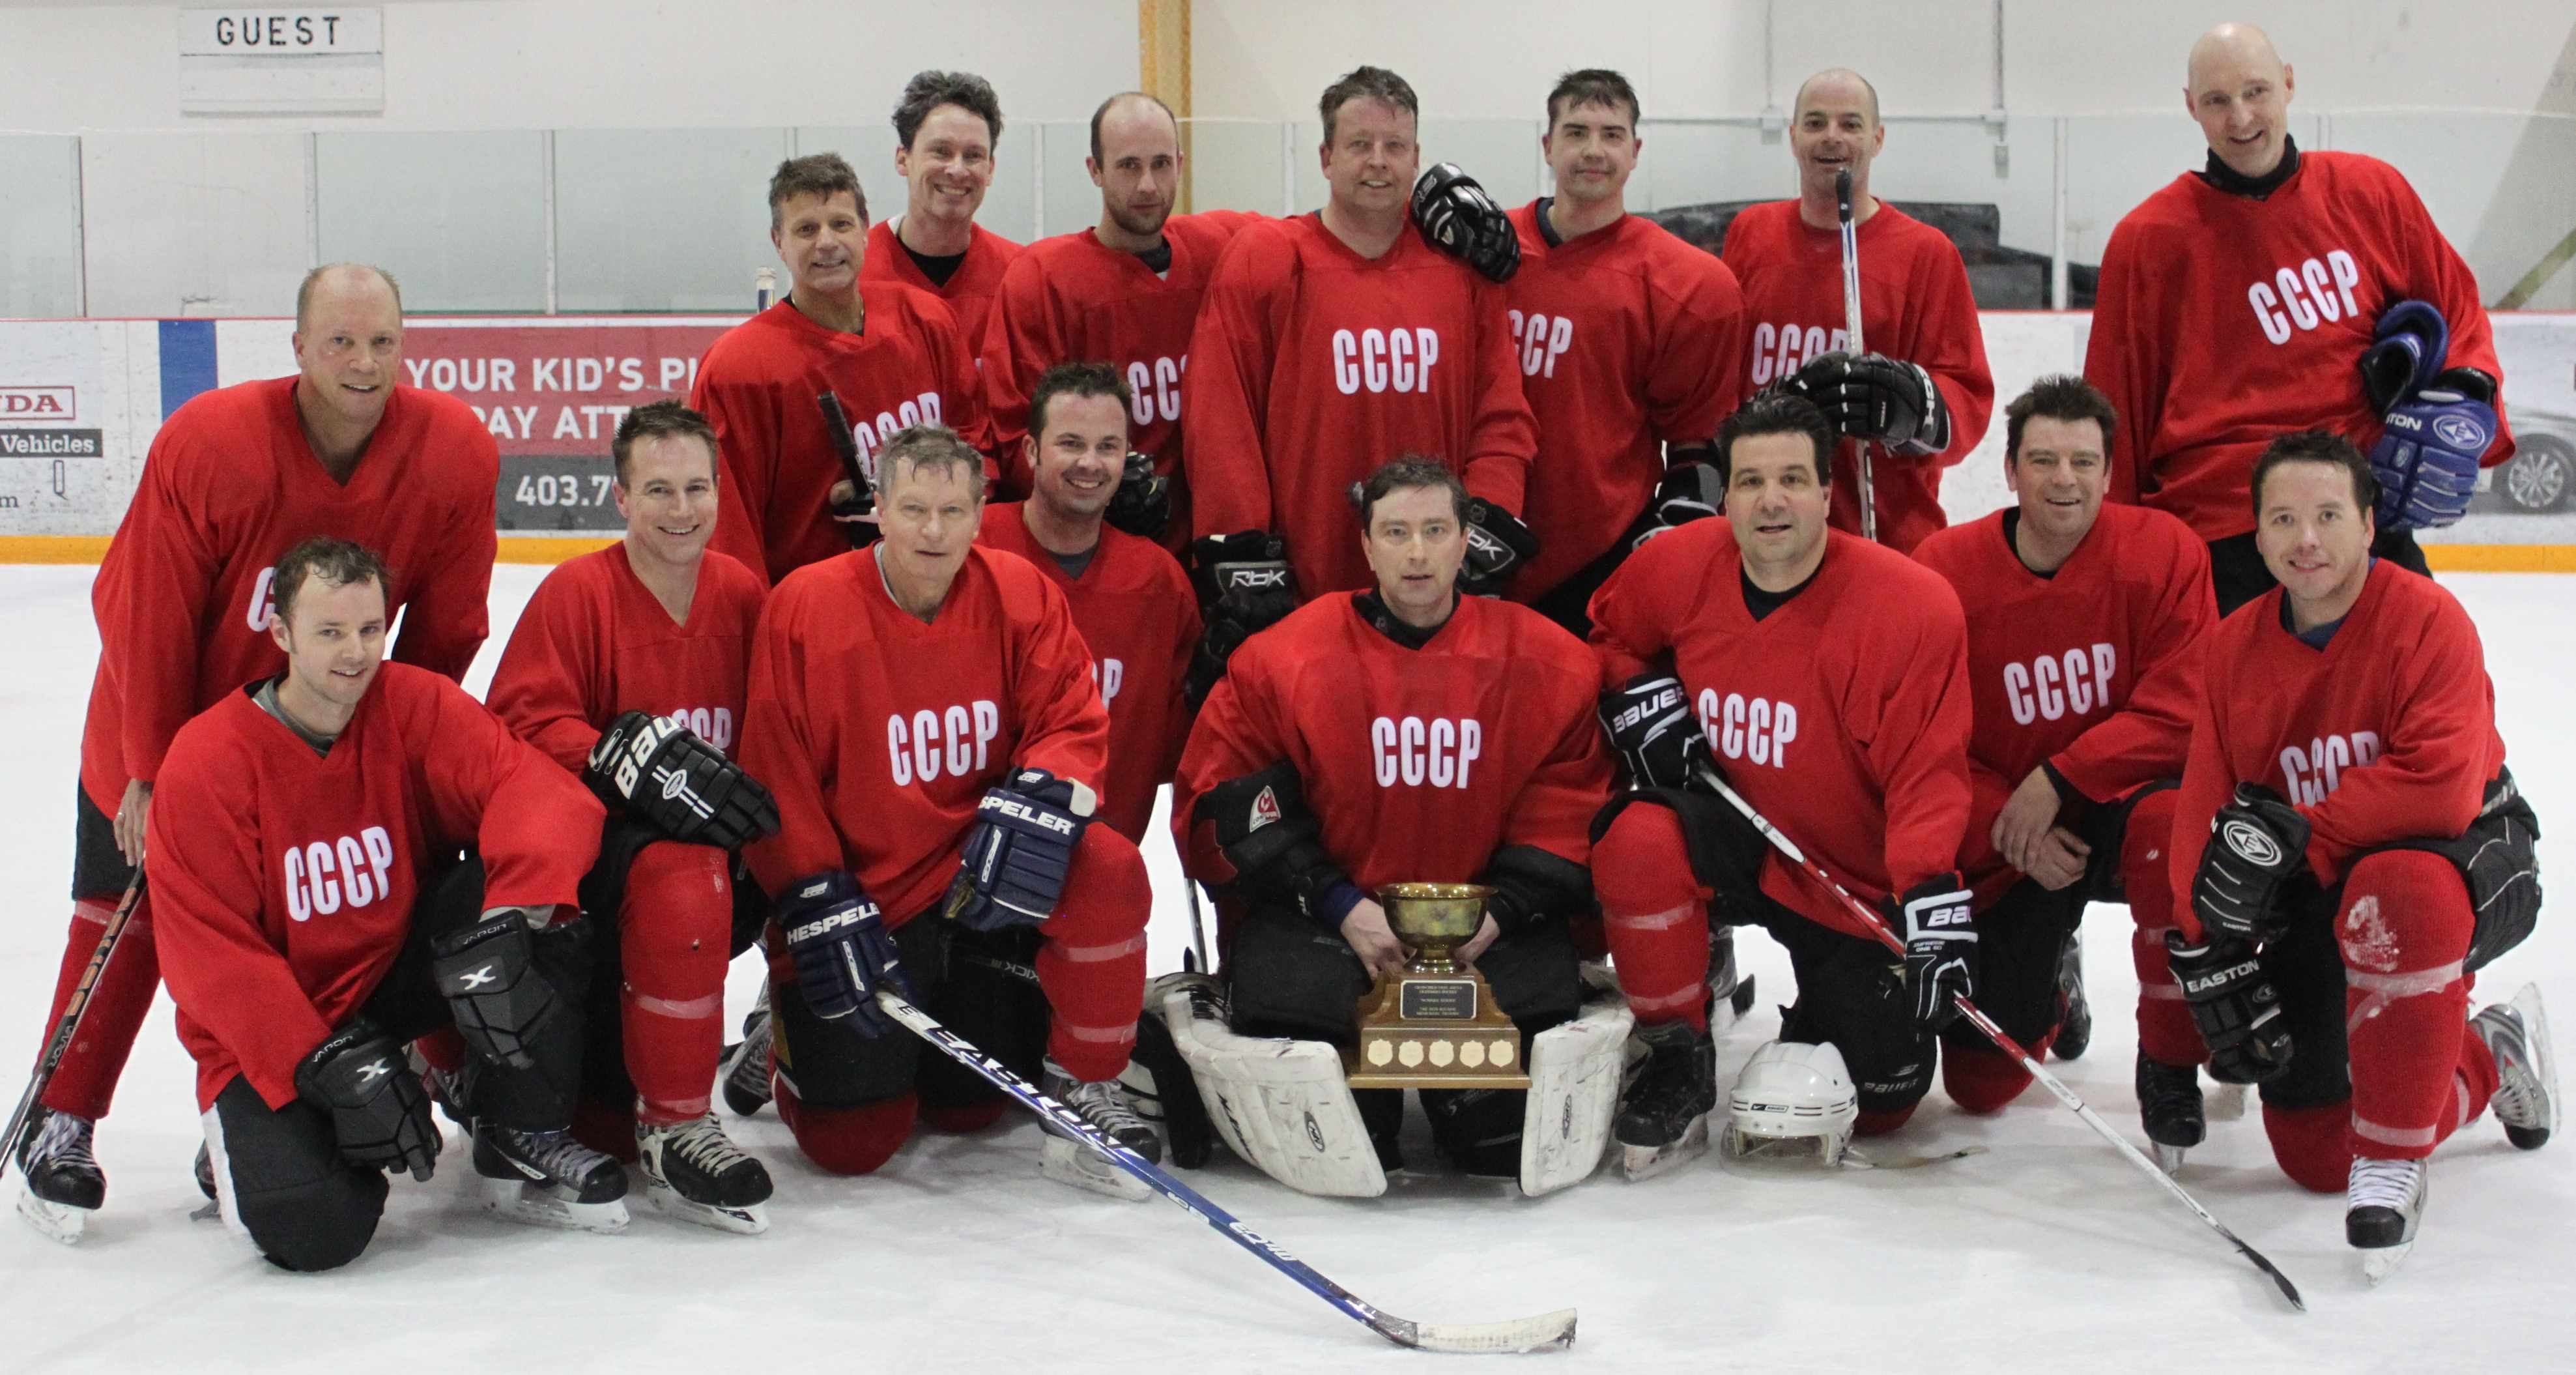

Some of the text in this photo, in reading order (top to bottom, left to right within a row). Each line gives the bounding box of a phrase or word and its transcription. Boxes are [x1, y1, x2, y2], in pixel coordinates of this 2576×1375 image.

[216, 17, 339, 46] GUEST
[405, 358, 515, 391] YOUR
[533, 358, 644, 391] KID'S
[1332, 328, 1438, 395] CCCP
[1, 434, 94, 453] Vehicles
[515, 475, 618, 506] 403.7
[887, 699, 999, 786] CCCP
[1371, 716, 1481, 789] CCCP
[1927, 905, 1971, 927] BA
[2186, 959, 2260, 993] EASTON
